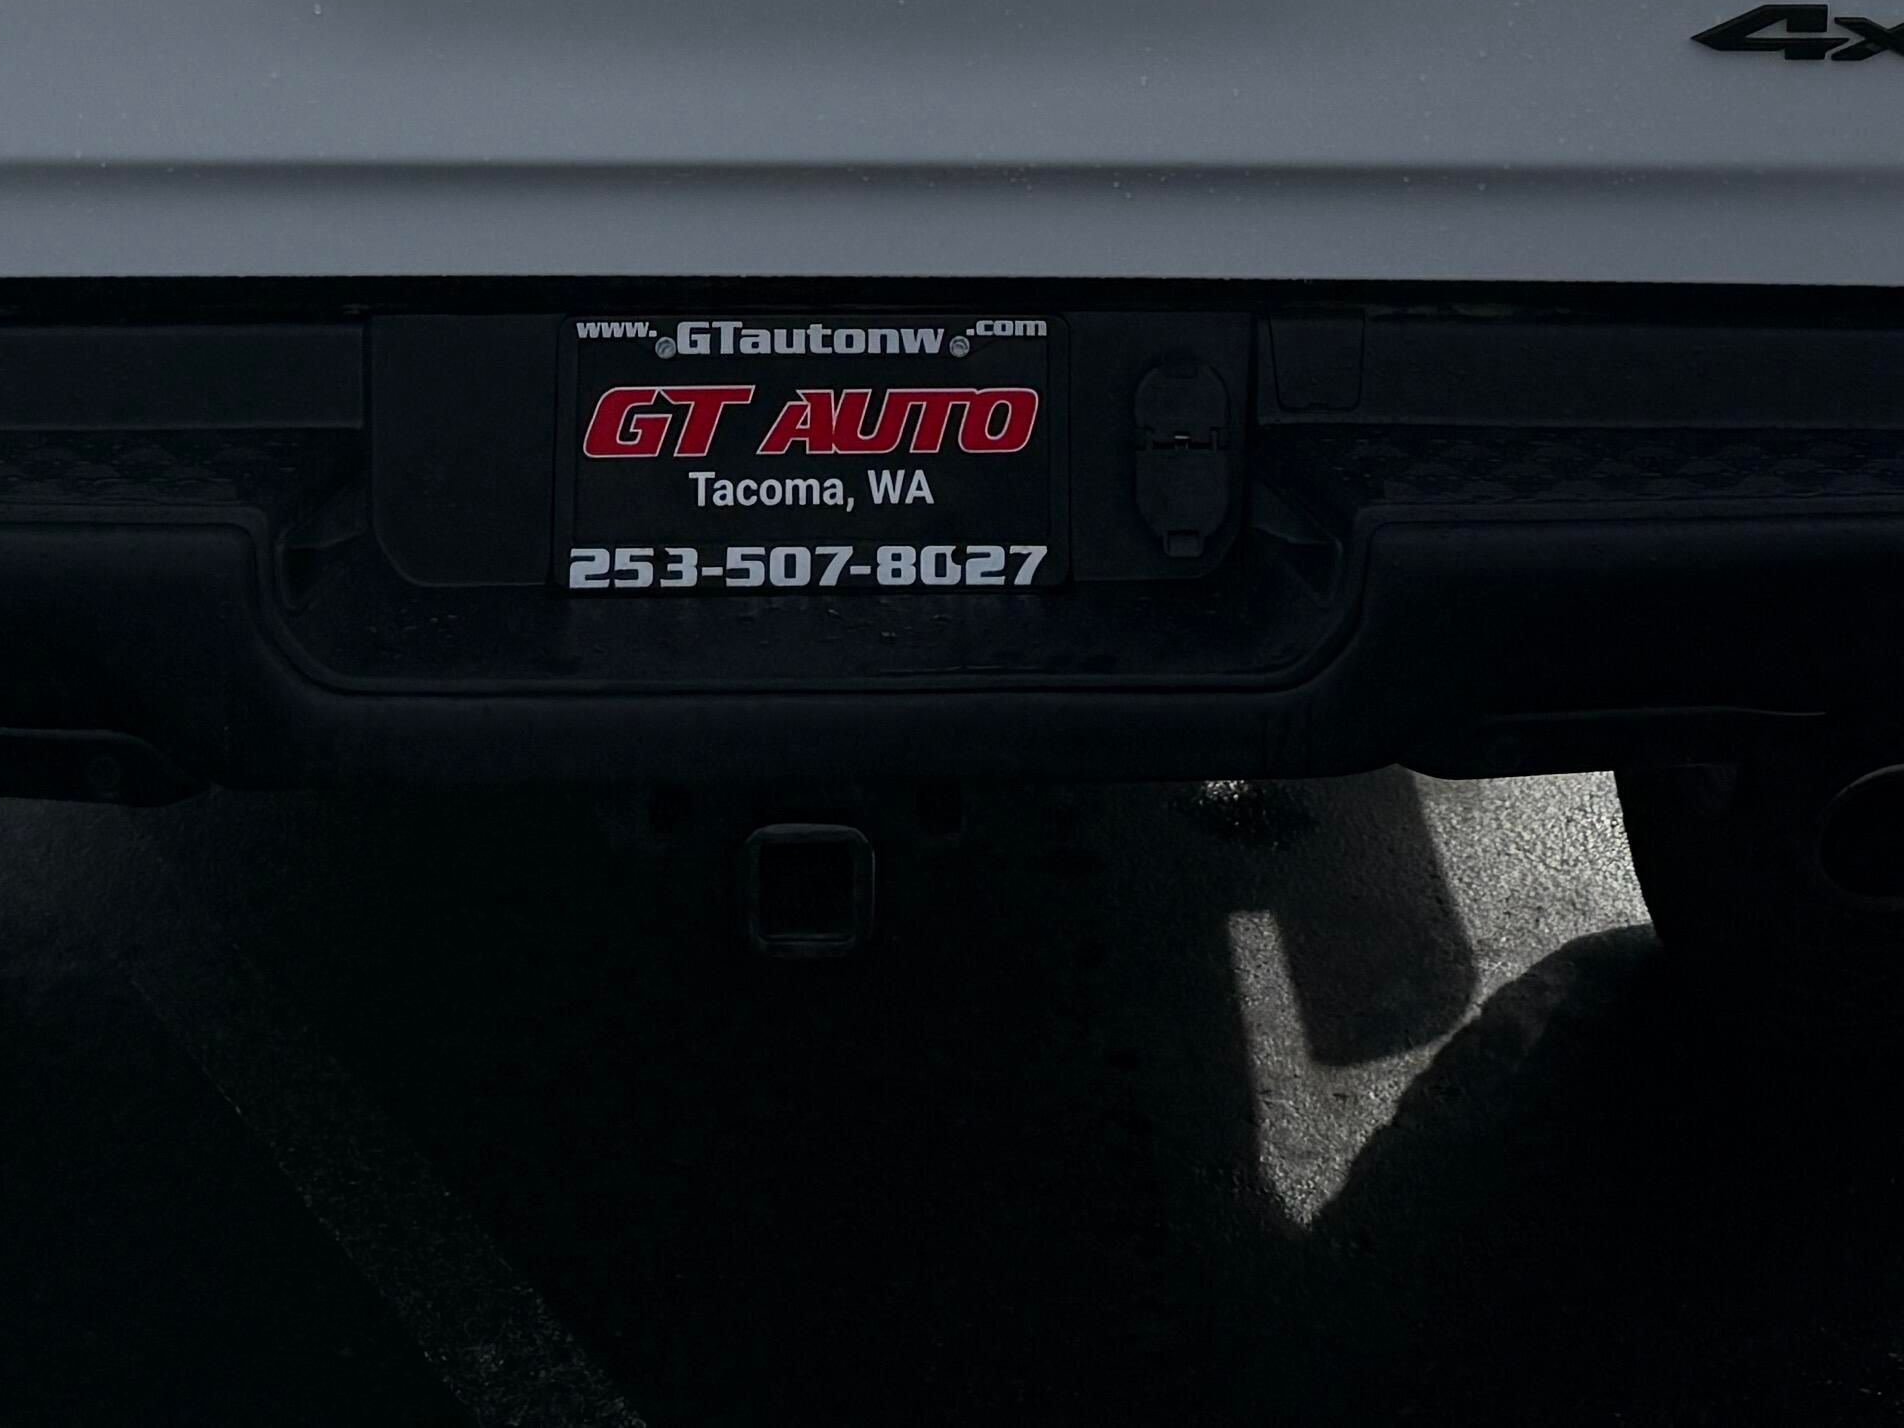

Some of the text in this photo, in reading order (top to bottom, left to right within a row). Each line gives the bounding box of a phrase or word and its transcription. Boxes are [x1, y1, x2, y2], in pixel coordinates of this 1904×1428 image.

[583, 385, 1039, 458] GT AUTO
[688, 470, 934, 512] Tacoma, WA
[569, 546, 1048, 589] 253-507-8027
